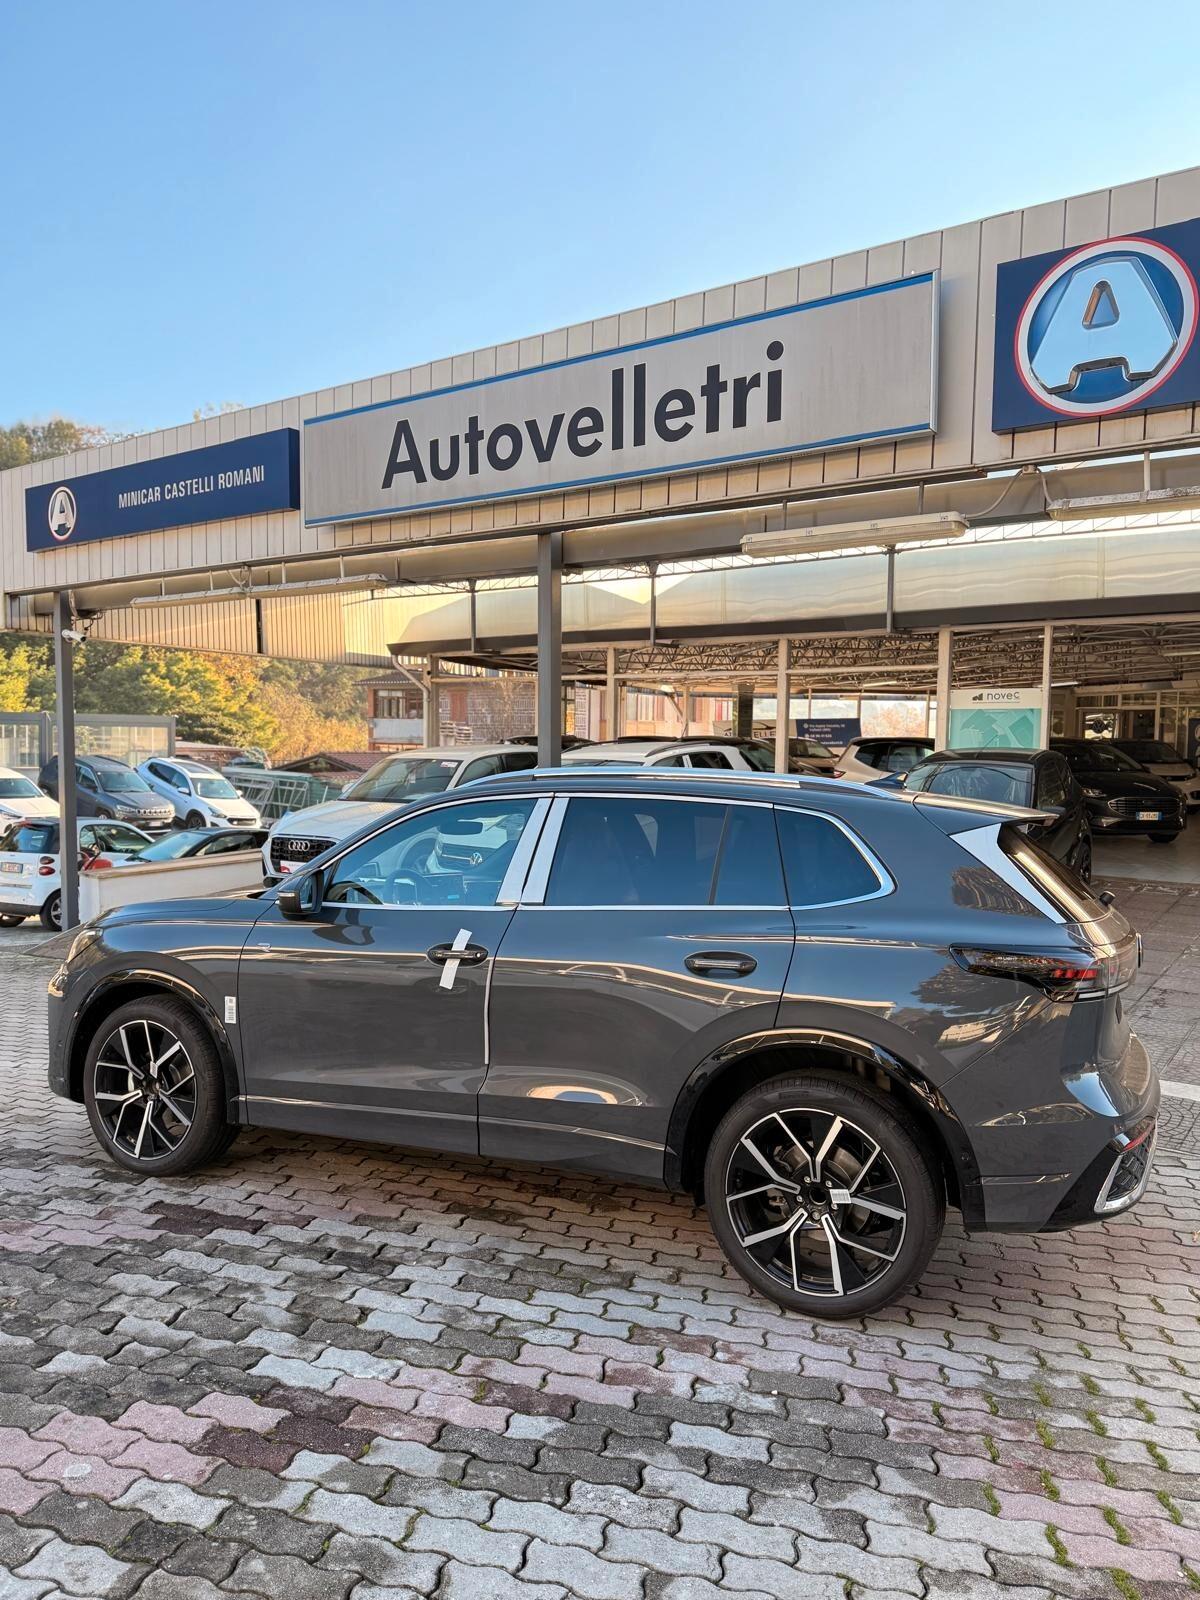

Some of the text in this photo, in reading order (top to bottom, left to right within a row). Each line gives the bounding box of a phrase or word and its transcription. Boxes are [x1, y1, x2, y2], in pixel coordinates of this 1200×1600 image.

[1031, 256, 1179, 395] A
[381, 340, 784, 490] Autovelletri
[118, 465, 265, 509] MINICAR CASTELLI ROMANI
